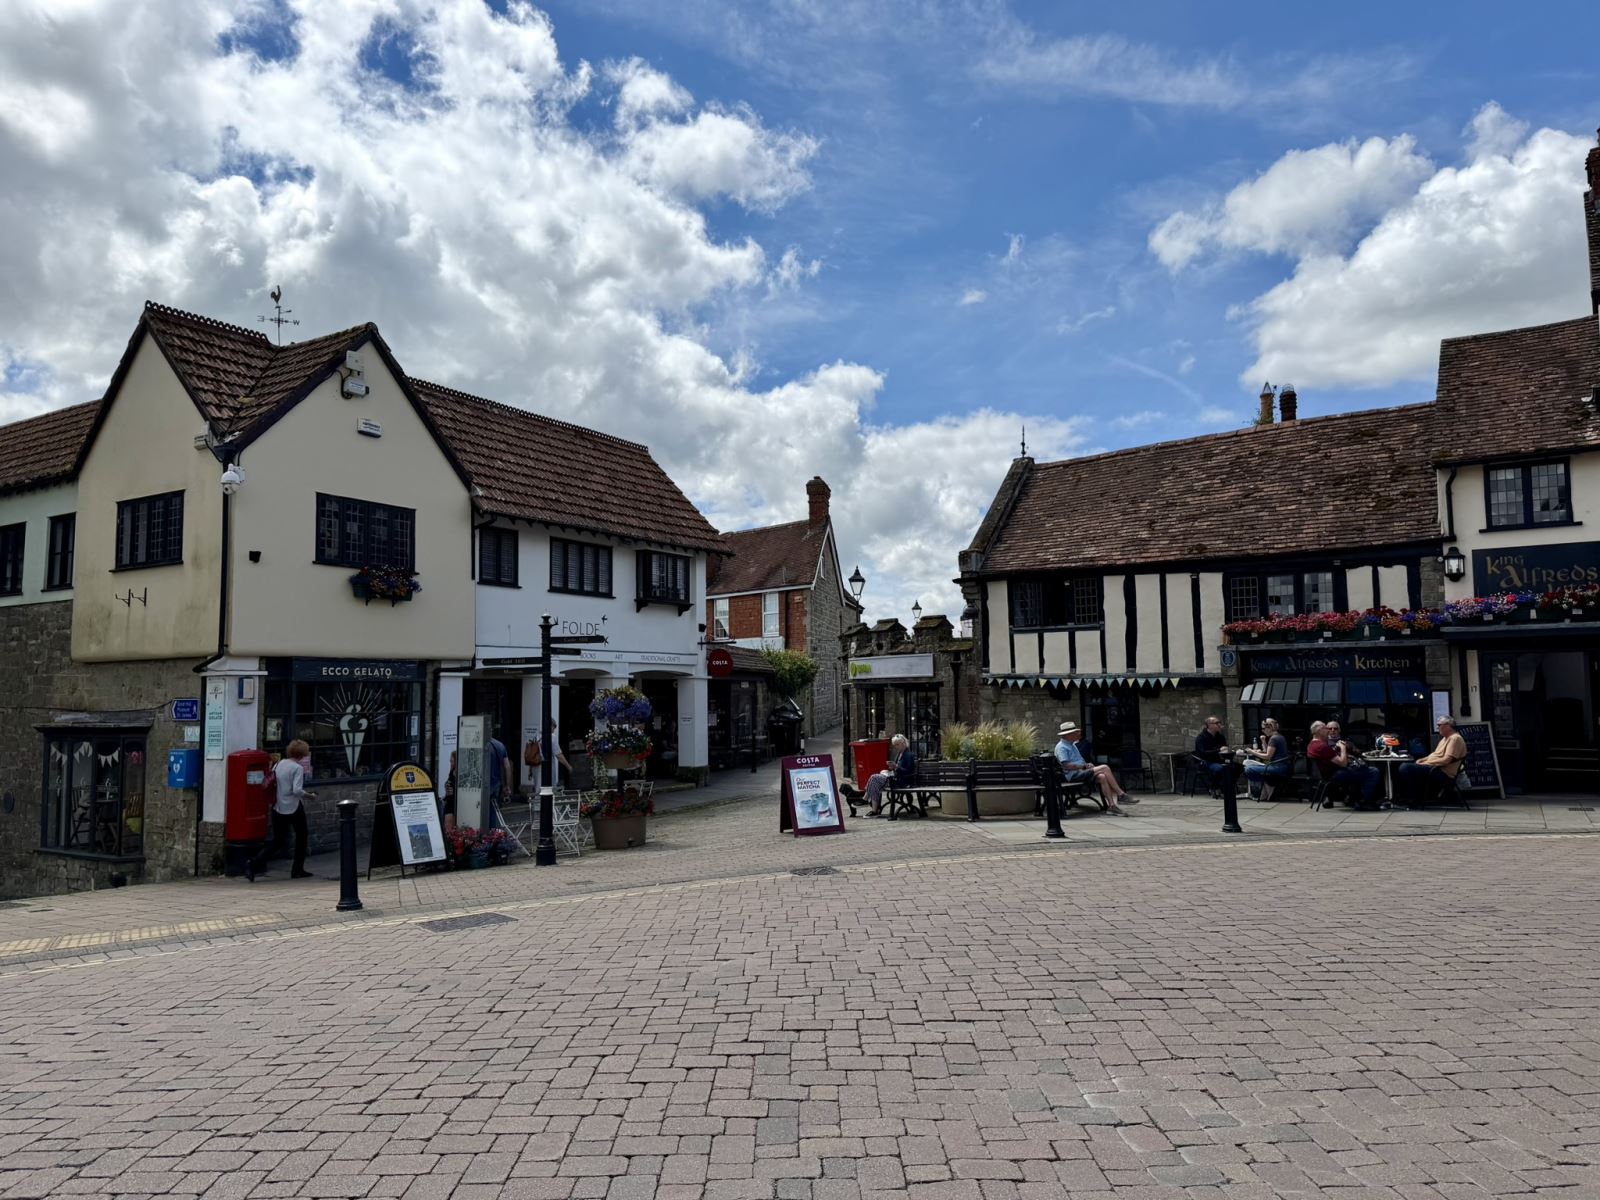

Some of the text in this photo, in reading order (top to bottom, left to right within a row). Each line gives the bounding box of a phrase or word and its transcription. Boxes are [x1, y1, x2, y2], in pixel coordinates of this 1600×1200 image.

[1354, 653, 1411, 671] Kitchen
[322, 667, 392, 677] ECCO GELATO
